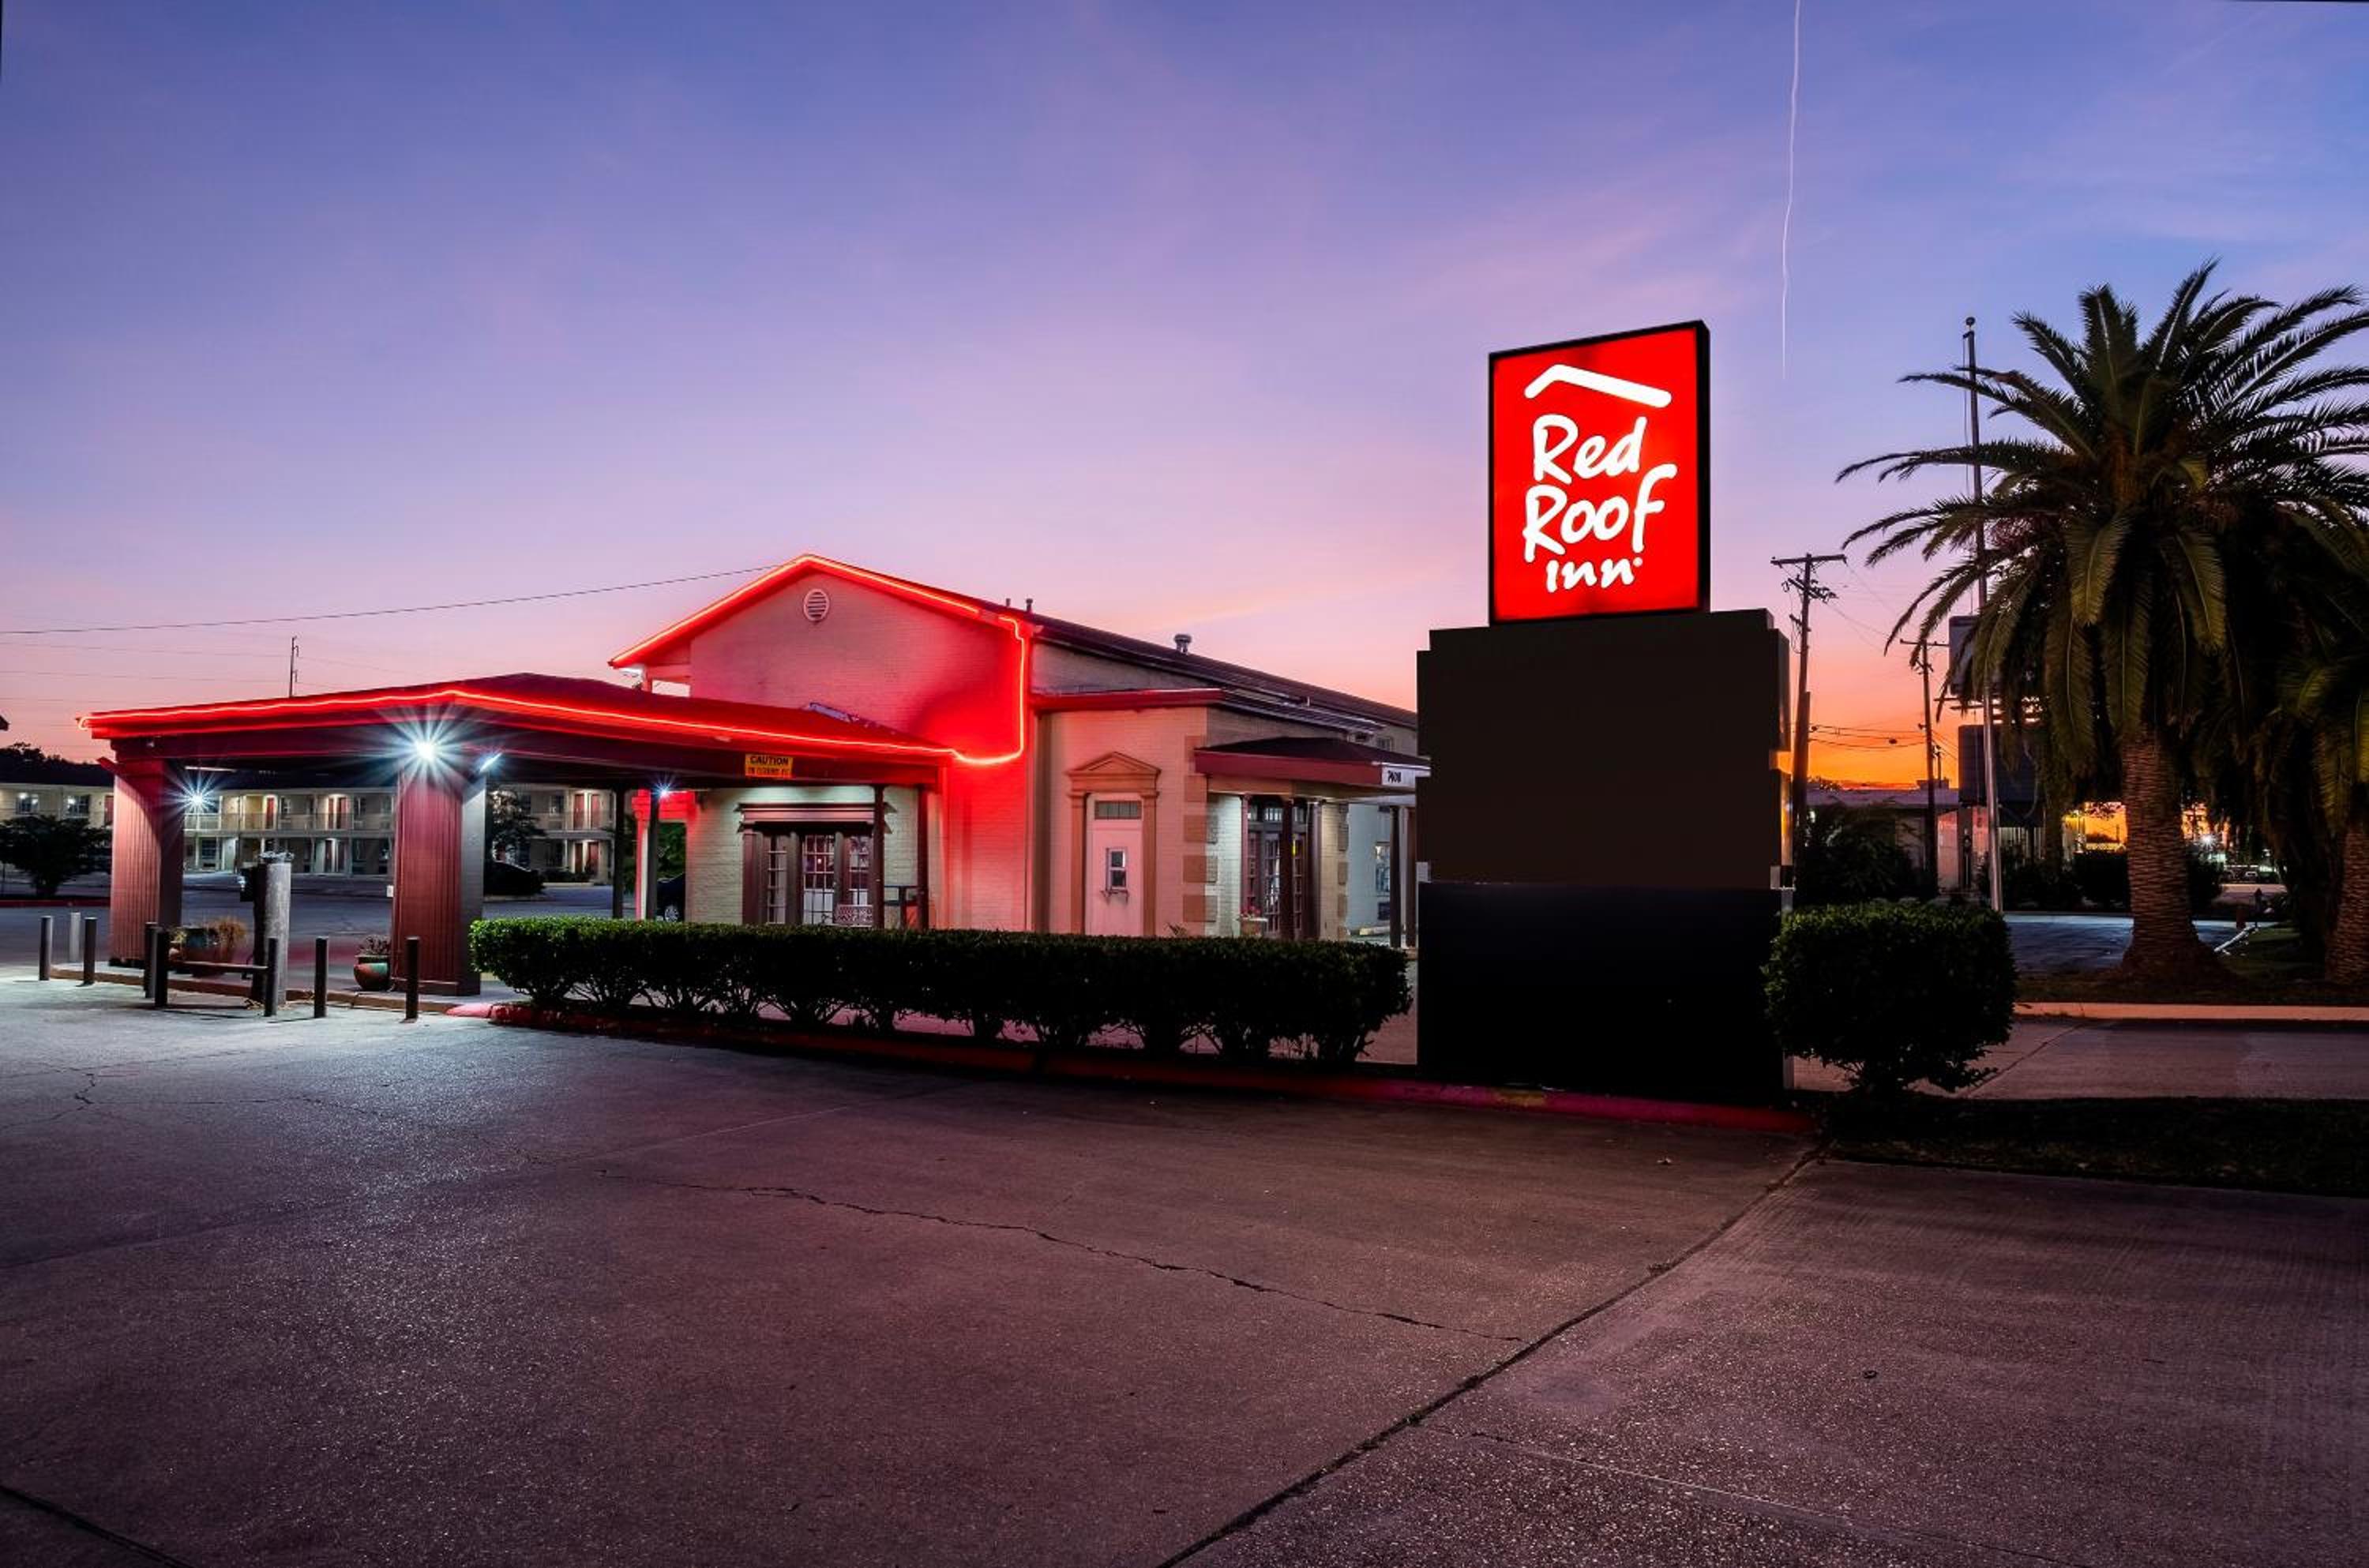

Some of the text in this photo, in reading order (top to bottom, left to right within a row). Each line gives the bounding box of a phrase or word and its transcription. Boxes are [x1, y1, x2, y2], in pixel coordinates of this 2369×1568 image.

[1533, 414, 1647, 485] Red
[1522, 463, 1678, 563] Roof
[1546, 558, 1635, 593] inn
[749, 756, 789, 765] CAUTION
